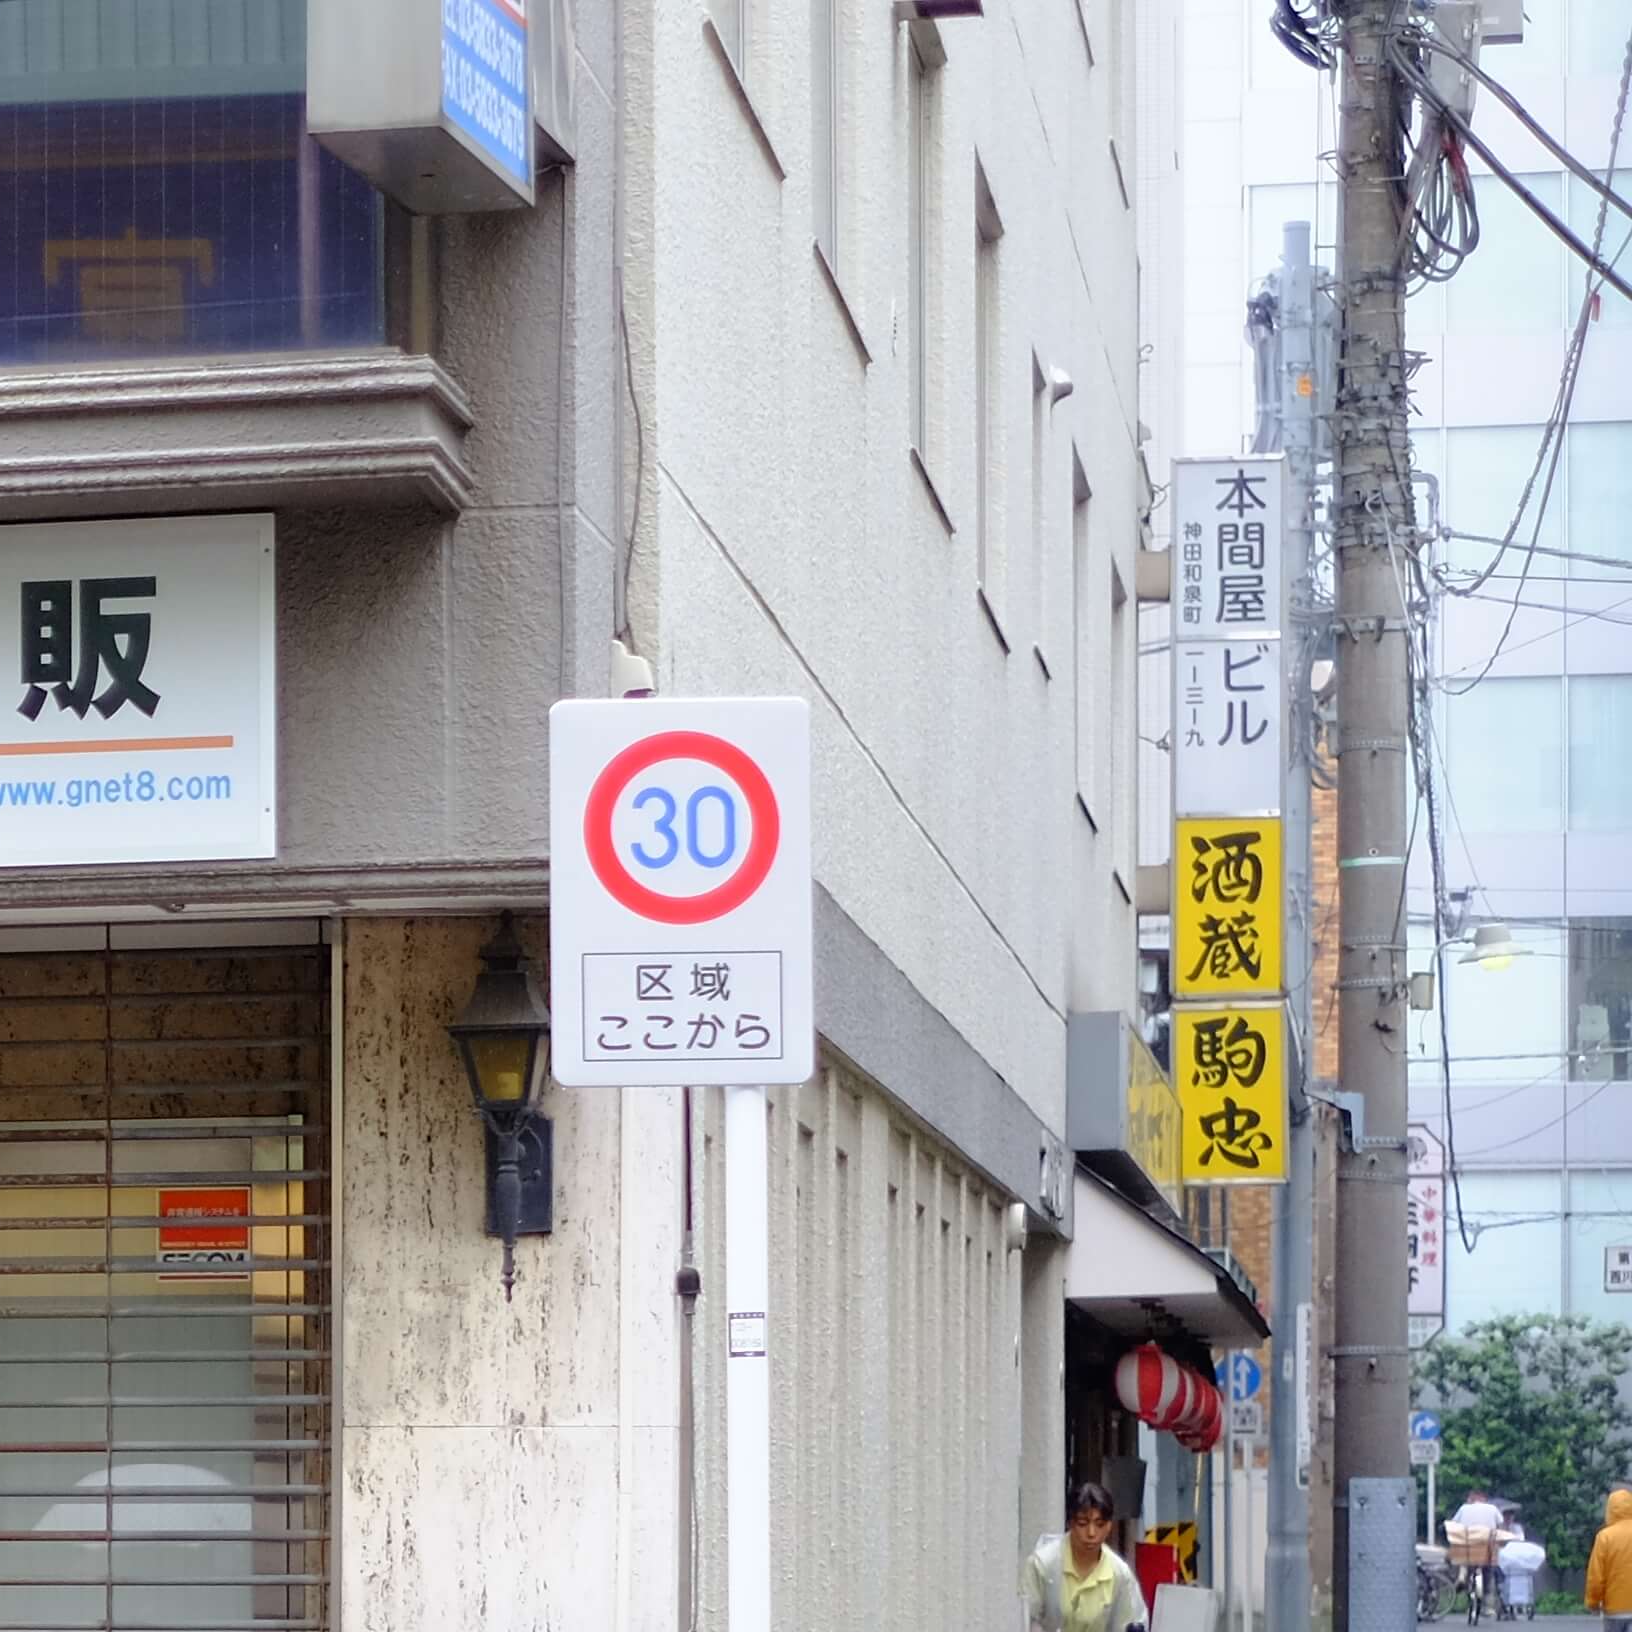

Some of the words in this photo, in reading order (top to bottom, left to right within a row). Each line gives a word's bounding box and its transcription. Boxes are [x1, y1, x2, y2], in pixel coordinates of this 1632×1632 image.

[1214, 467, 1268, 747] 本間屋ビル
[630, 785, 737, 870] 30
[1185, 831, 1264, 982] 酒蔵
[596, 1012, 772, 1051] ここから
[636, 961, 731, 1002] 区域
[1192, 1015, 1273, 1169] 駒忠
